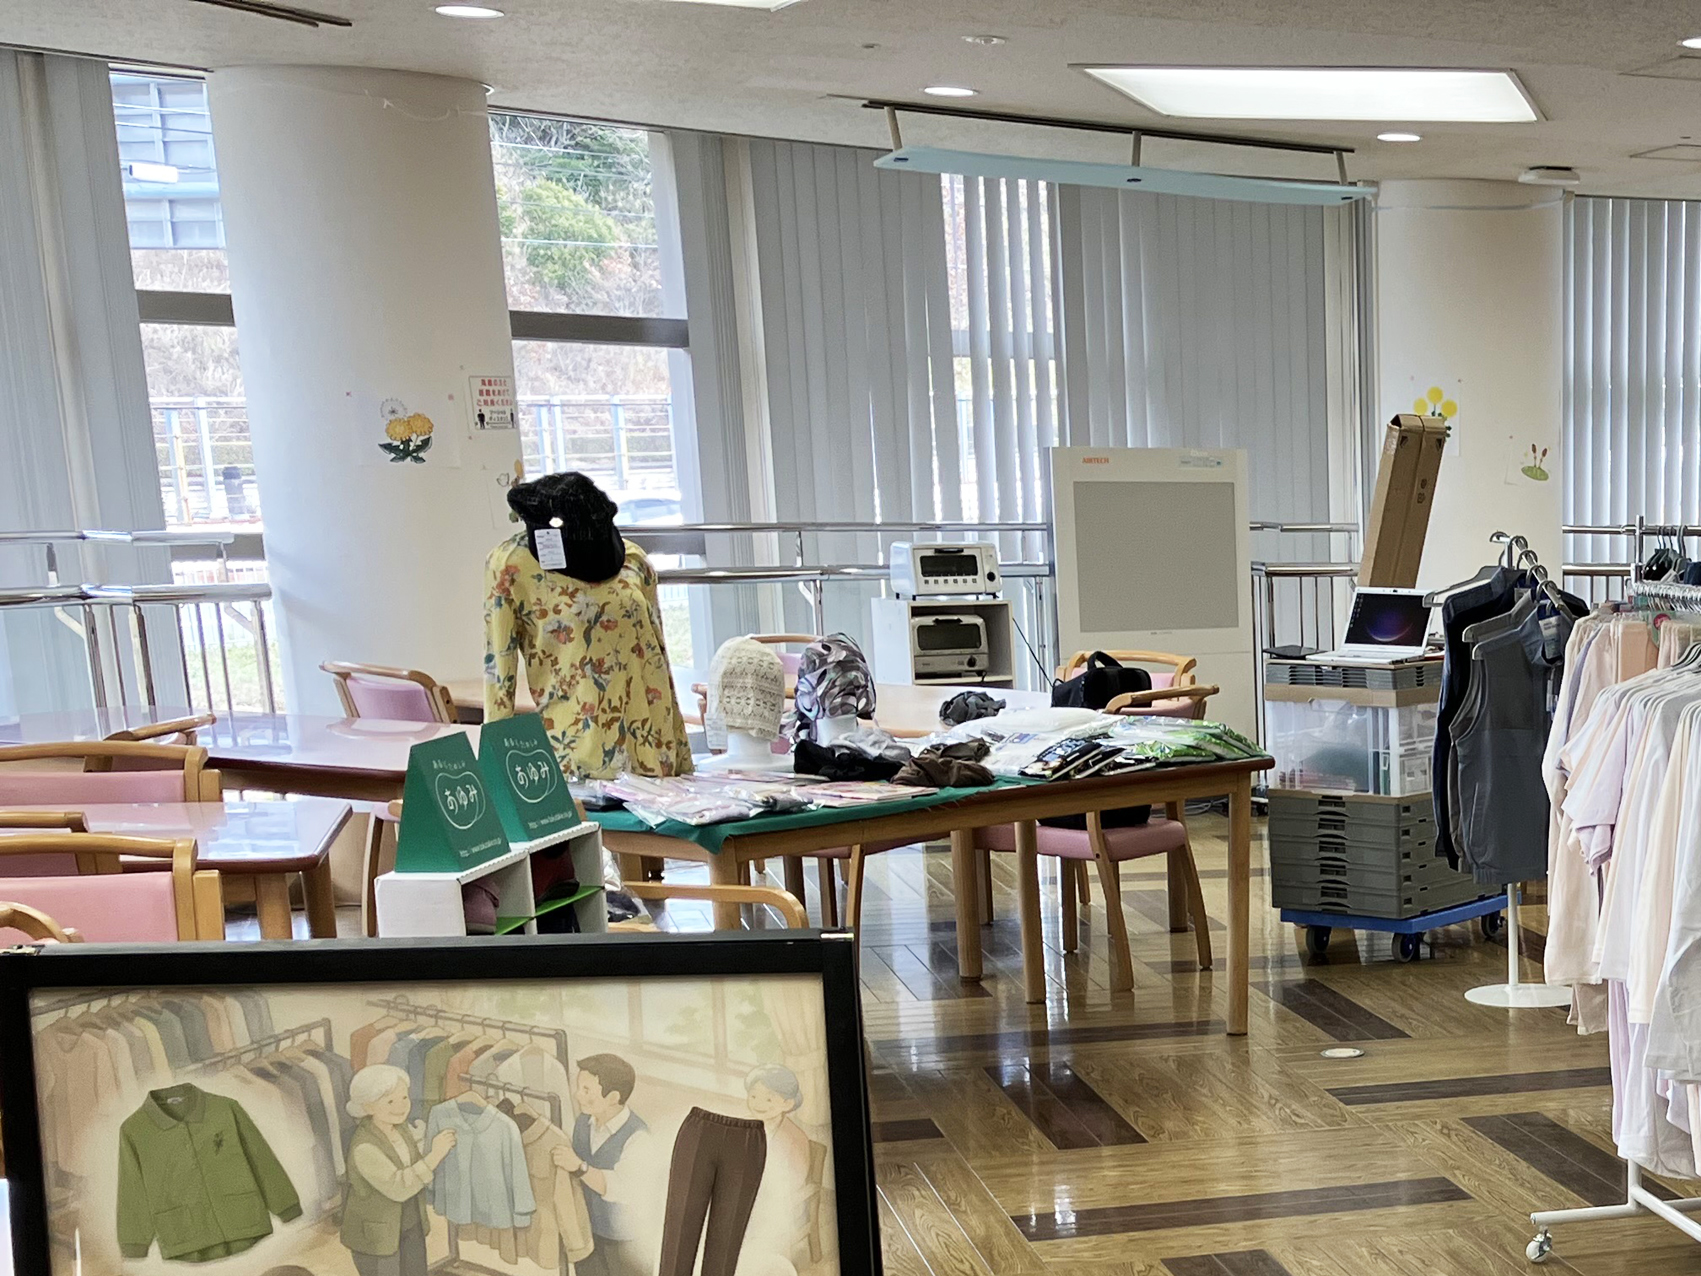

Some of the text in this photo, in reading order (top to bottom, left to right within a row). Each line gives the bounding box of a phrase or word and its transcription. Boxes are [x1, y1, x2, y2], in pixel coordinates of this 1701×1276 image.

[515, 761, 550, 789] あゆみ
[444, 784, 478, 815] あゆみ
